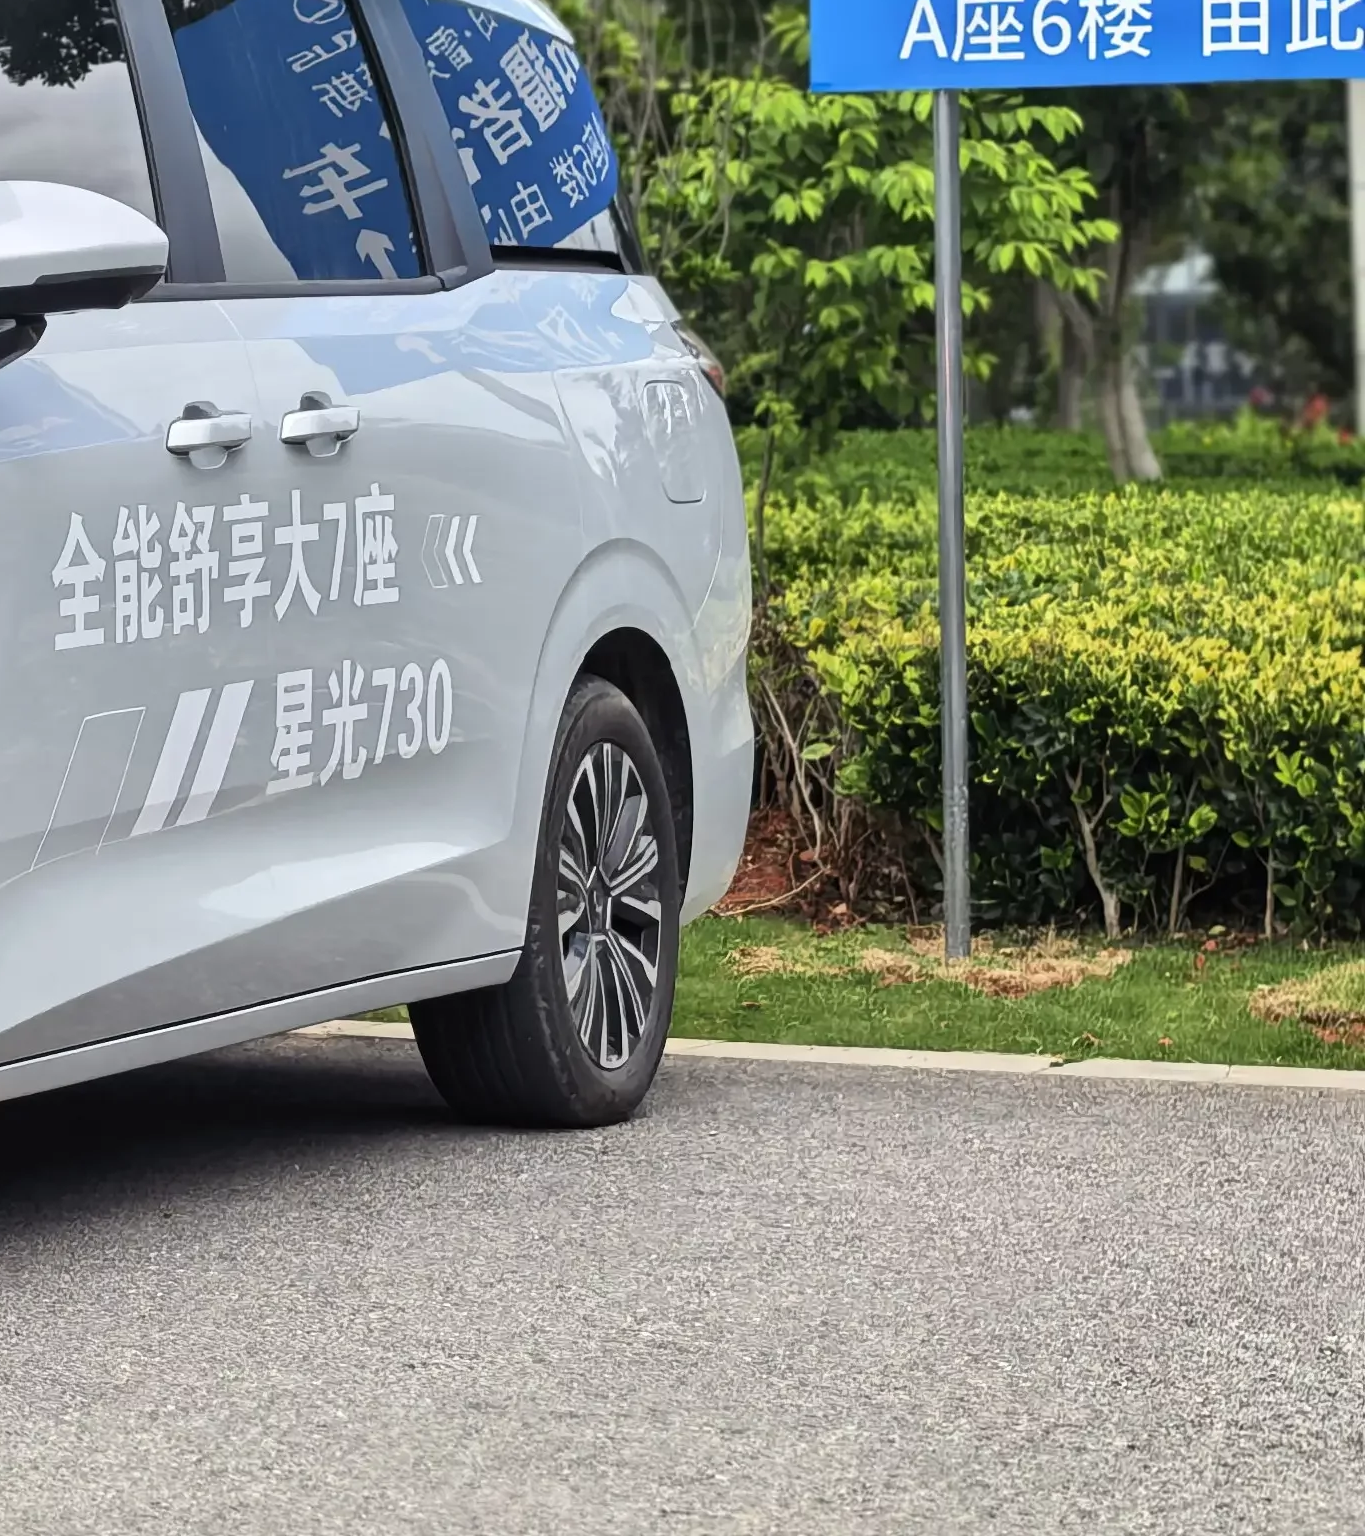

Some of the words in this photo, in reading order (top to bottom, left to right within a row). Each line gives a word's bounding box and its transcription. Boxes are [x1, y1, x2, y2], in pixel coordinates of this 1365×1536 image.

[52, 483, 399, 651] 全能舒享大7座
[265, 658, 452, 795] 星光730
